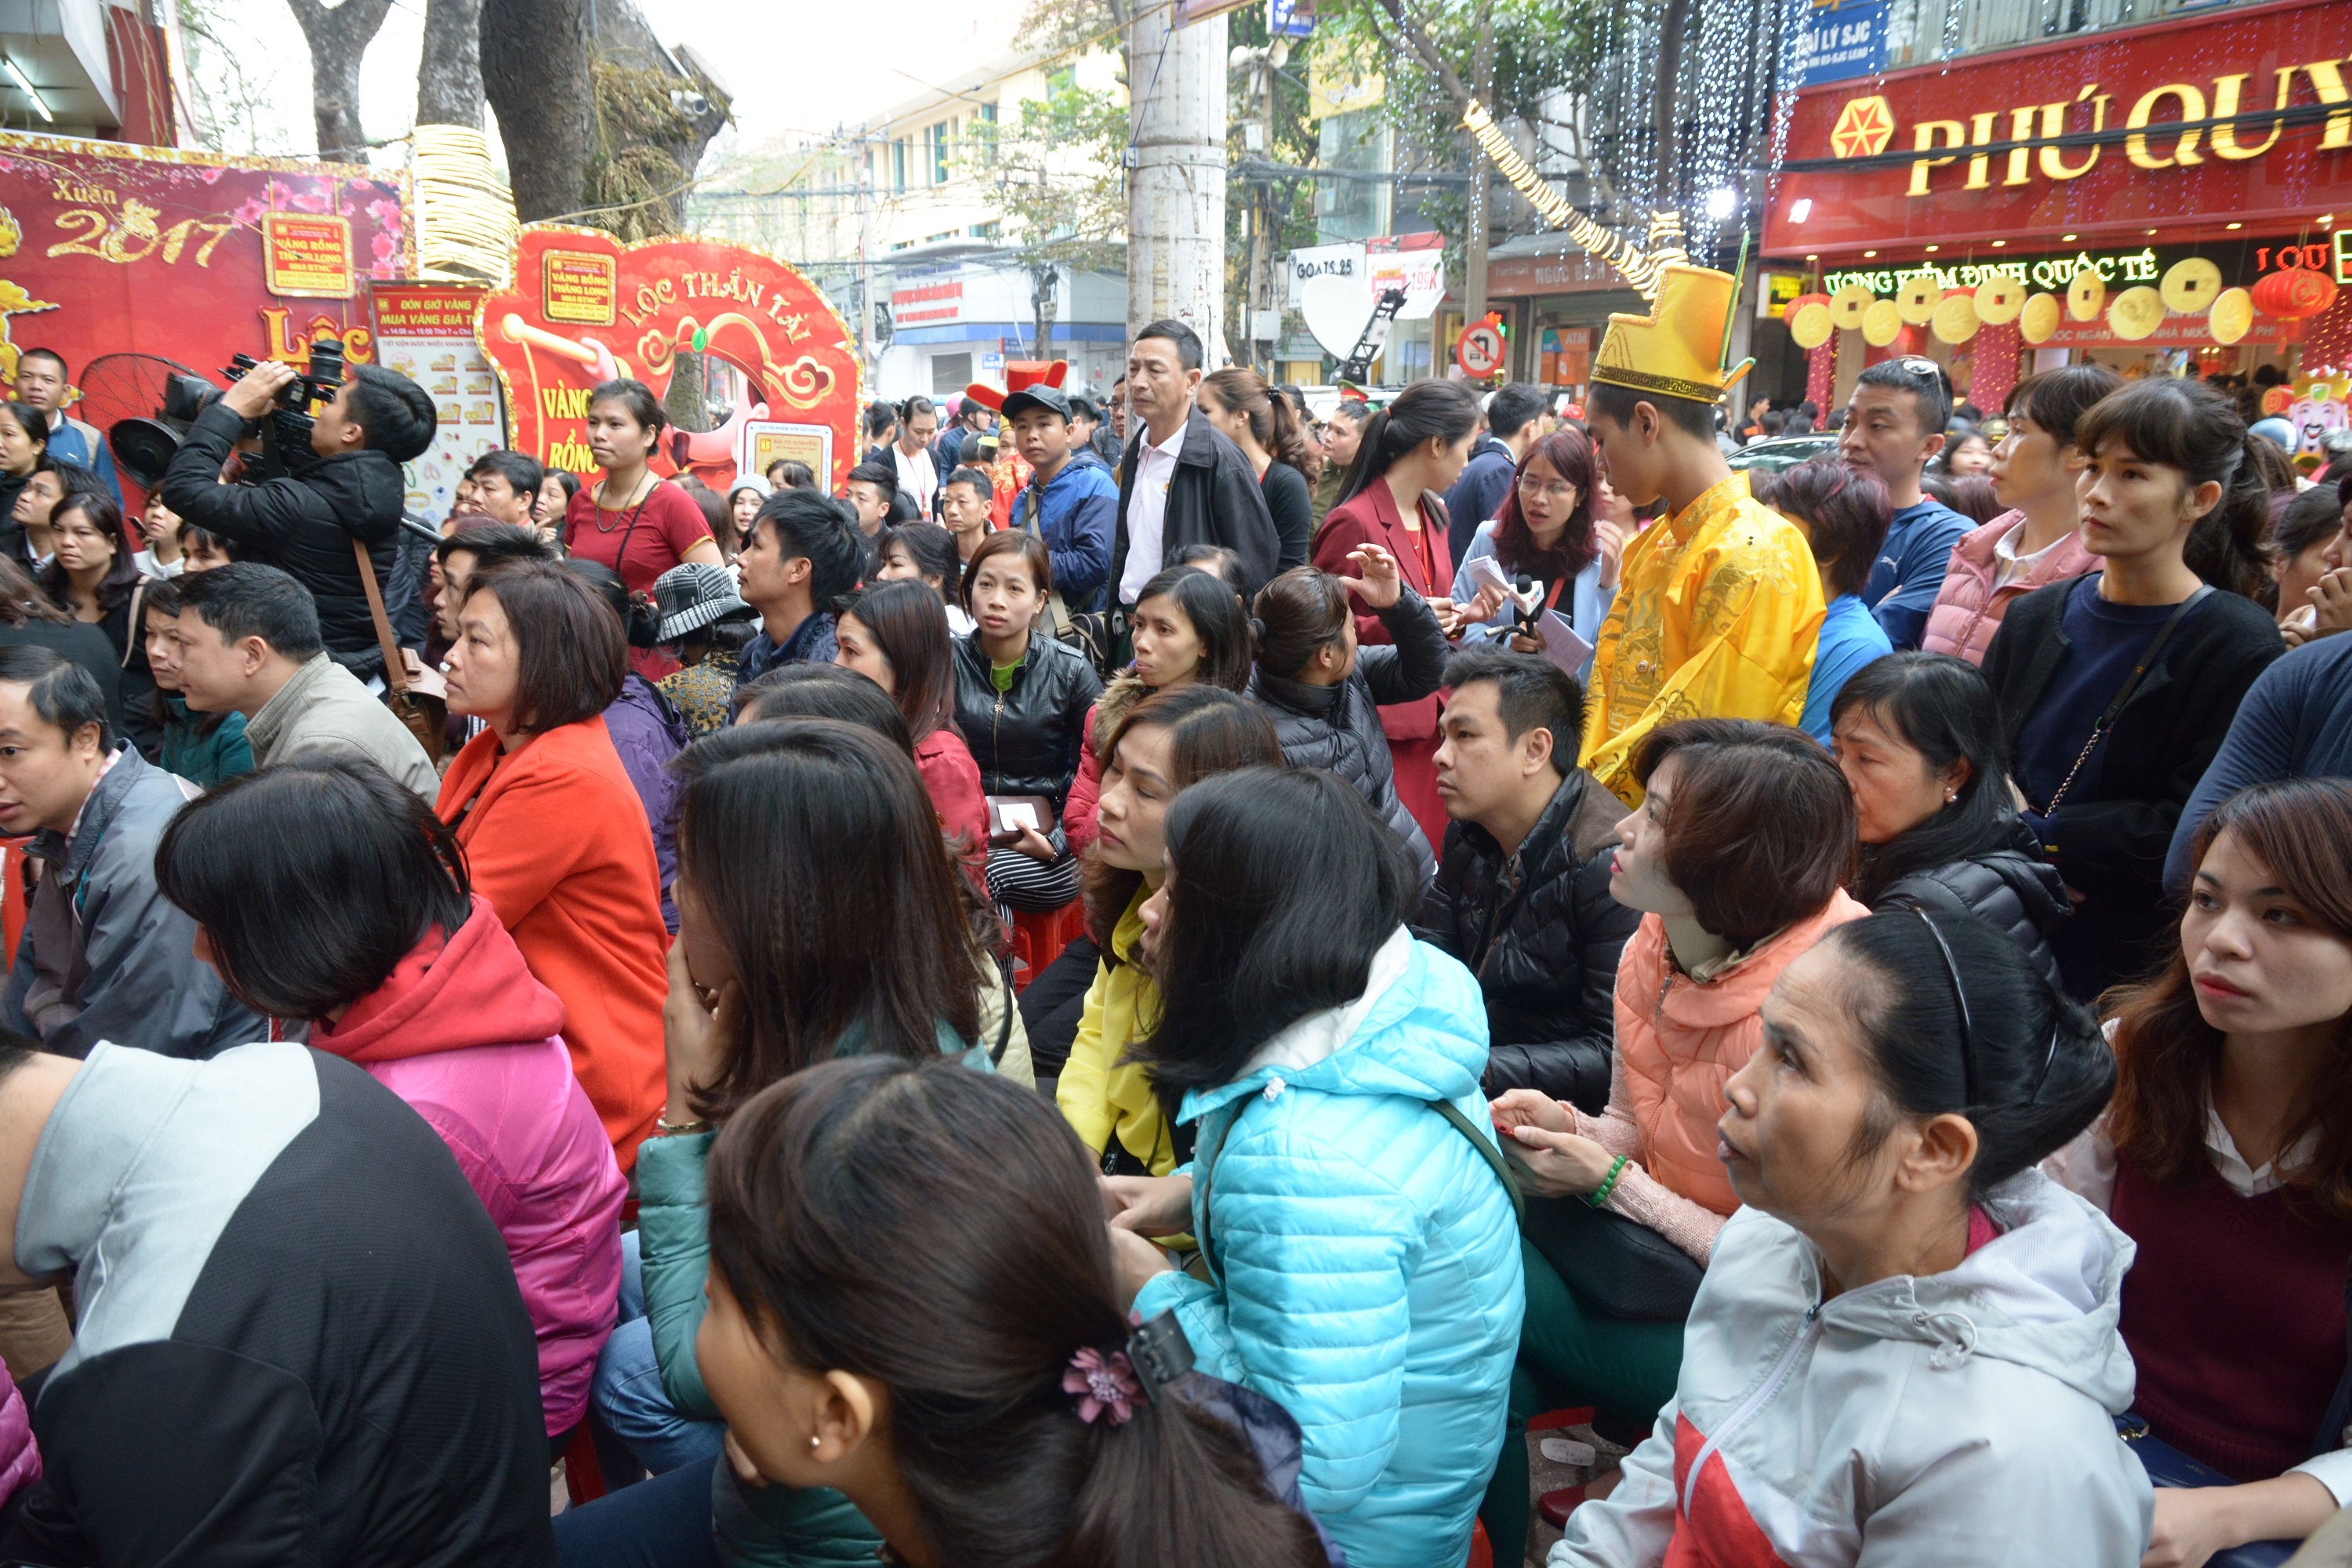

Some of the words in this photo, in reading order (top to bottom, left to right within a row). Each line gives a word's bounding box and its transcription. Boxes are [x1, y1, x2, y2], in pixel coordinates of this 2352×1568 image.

[1821, 23, 1840, 52] LÝ
[1841, 20, 1871, 47] SJC
[1905, 83, 2114, 197] PHÚ
[2118, 247, 2159, 281] TẾ
[552, 270, 579, 284] VÀNG
[1412, 270, 1437, 291] 199K
[1535, 264, 1570, 287] NGỌC
[583, 286, 608, 297] LONG
[444, 298, 471, 310] VÀNG
[618, 277, 677, 328] LỘC
[380, 314, 407, 325] MUA
[408, 311, 441, 325] VÀNG
[1565, 332, 1588, 344] ATM
